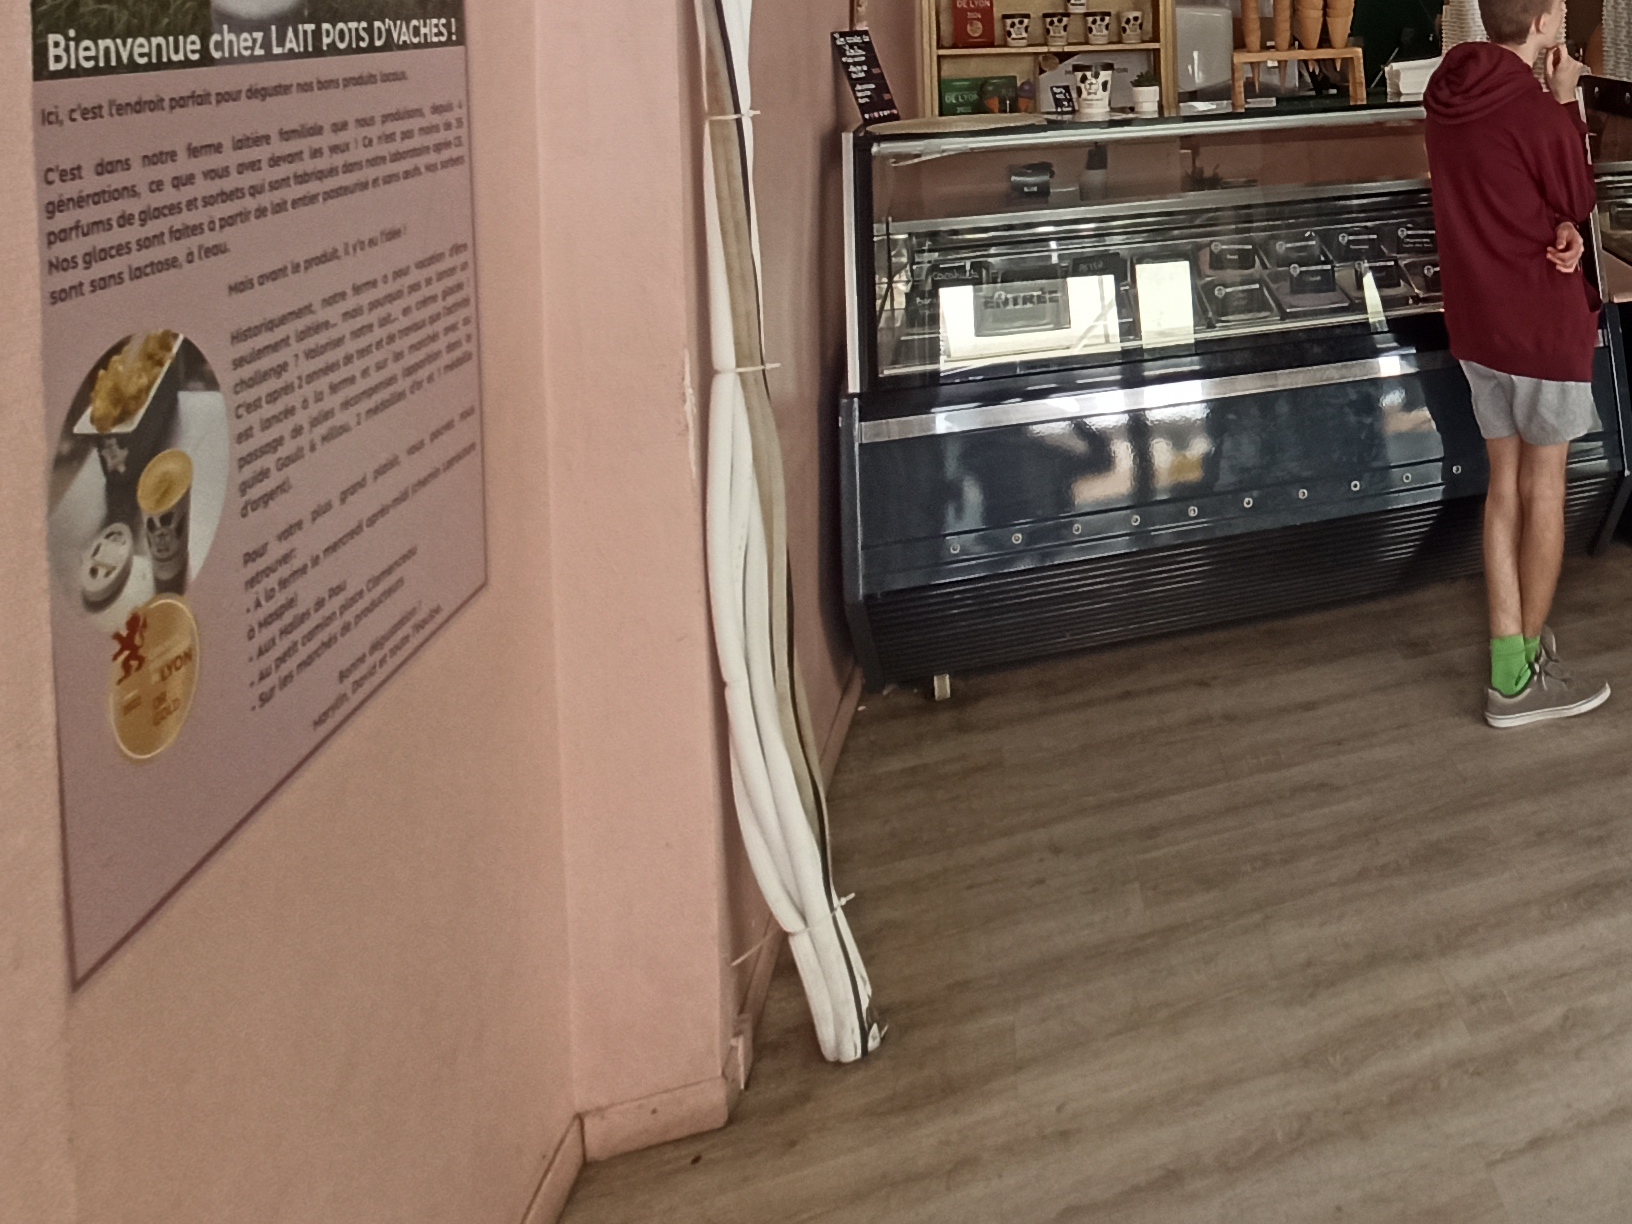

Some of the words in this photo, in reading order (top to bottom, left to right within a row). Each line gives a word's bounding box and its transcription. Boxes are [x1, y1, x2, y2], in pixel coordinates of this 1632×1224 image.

[956, 0, 968, 8] DE
[47, 29, 201, 72] Bienvenue
[209, 24, 265, 59] chez
[271, 23, 316, 55] LAIT
[322, 21, 370, 51] POTS
[374, 18, 449, 48] D'VACHES
[40, 105, 63, 126] Ici,
[67, 103, 103, 122] c'est
[108, 95, 165, 116] l'endroit
[168, 89, 212, 112] parfait
[214, 89, 242, 106] pour
[43, 164, 82, 185] C'est
[94, 157, 131, 175] dans
[141, 149, 177, 167] notre
[186, 141, 223, 158] ferme
[44, 184, 140, 218] générations,
[147, 179, 164, 193] ce
[170, 172, 195, 190] que
[201, 165, 230, 181] vous
[235, 159, 262, 175] avez
[46, 217, 112, 248] parfums
[116, 210, 135, 228] de
[138, 201, 182, 226] glaces
[184, 196, 198, 211] et
[201, 187, 245, 208] sorbets
[47, 254, 78, 274] Nos
[82, 241, 131, 269] glaces
[135, 231, 165, 251] sont
[168, 222, 204, 241] faites
[207, 217, 216, 232] à
[218, 208, 251, 231] partir
[49, 281, 84, 305] sont
[89, 271, 124, 293] sans
[128, 256, 182, 281] lactose,
[185, 248, 194, 264] à
[197, 242, 229, 260] l'eau.
[160, 647, 193, 681] LYON
